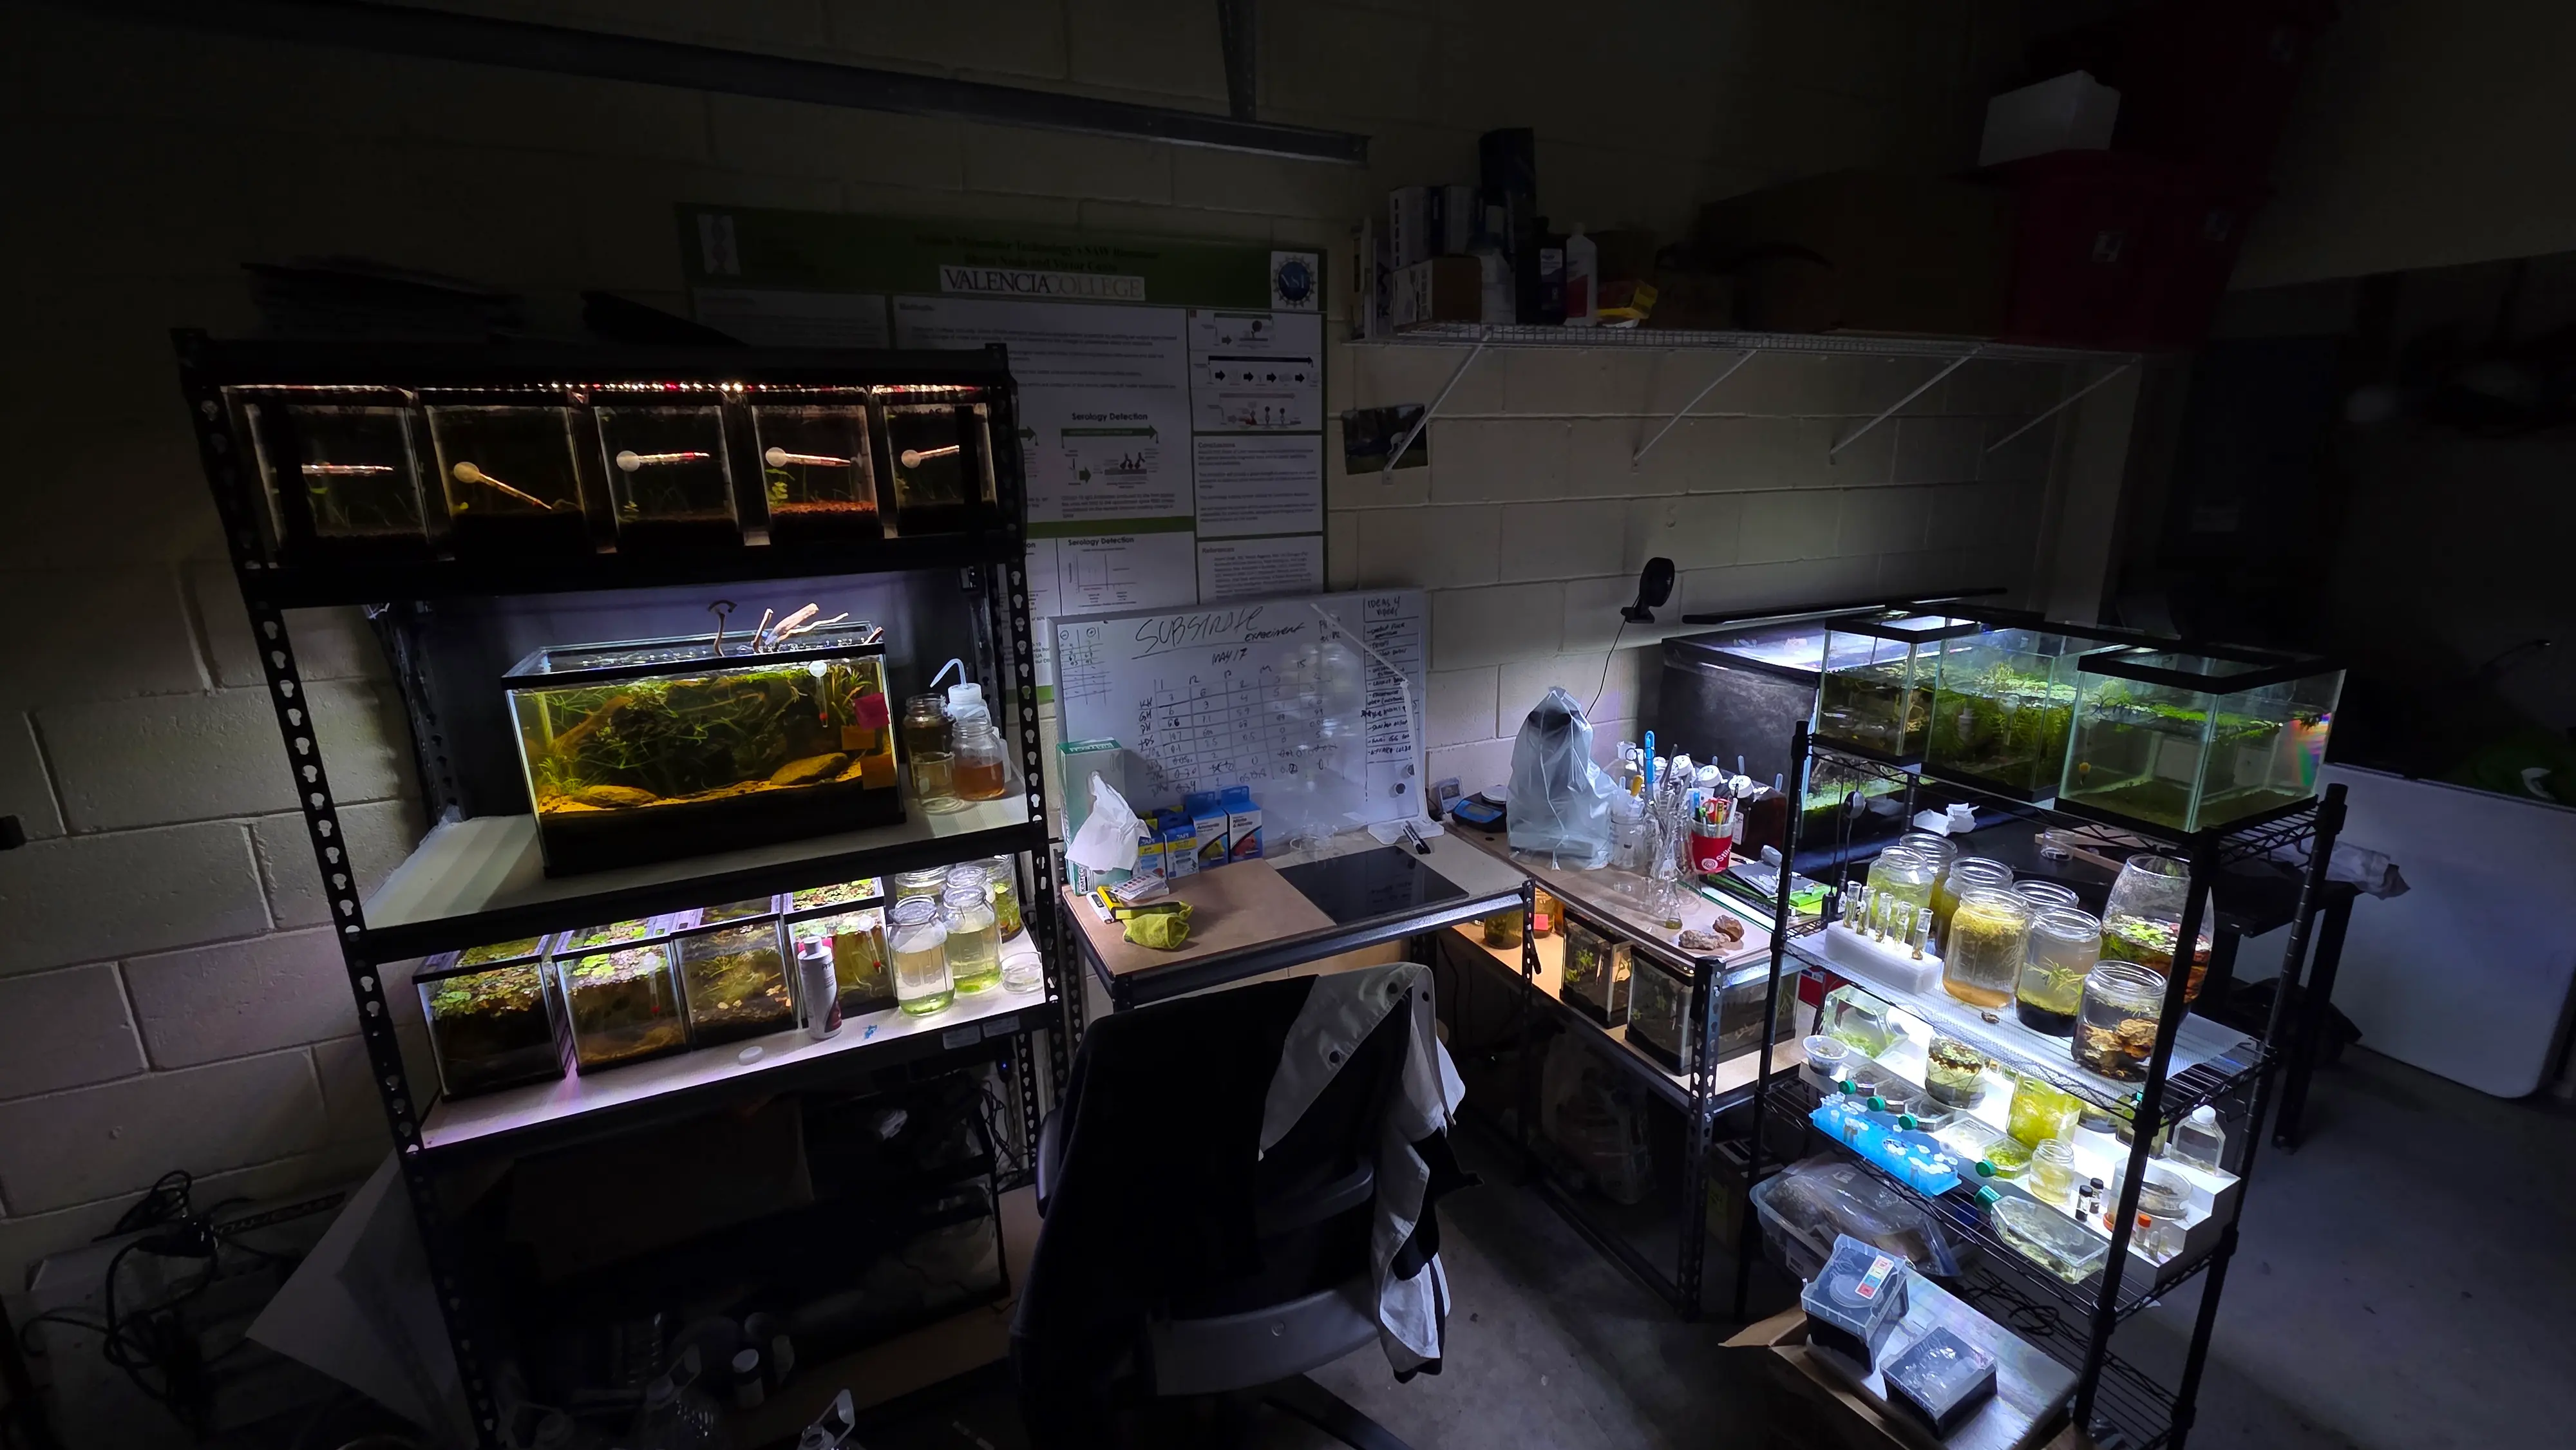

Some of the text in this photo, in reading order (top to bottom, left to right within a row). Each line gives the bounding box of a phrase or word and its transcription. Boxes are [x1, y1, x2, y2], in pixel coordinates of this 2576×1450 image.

[1072, 412, 1148, 422] Serology Detection
[1068, 536, 1135, 547] Serology Detection
